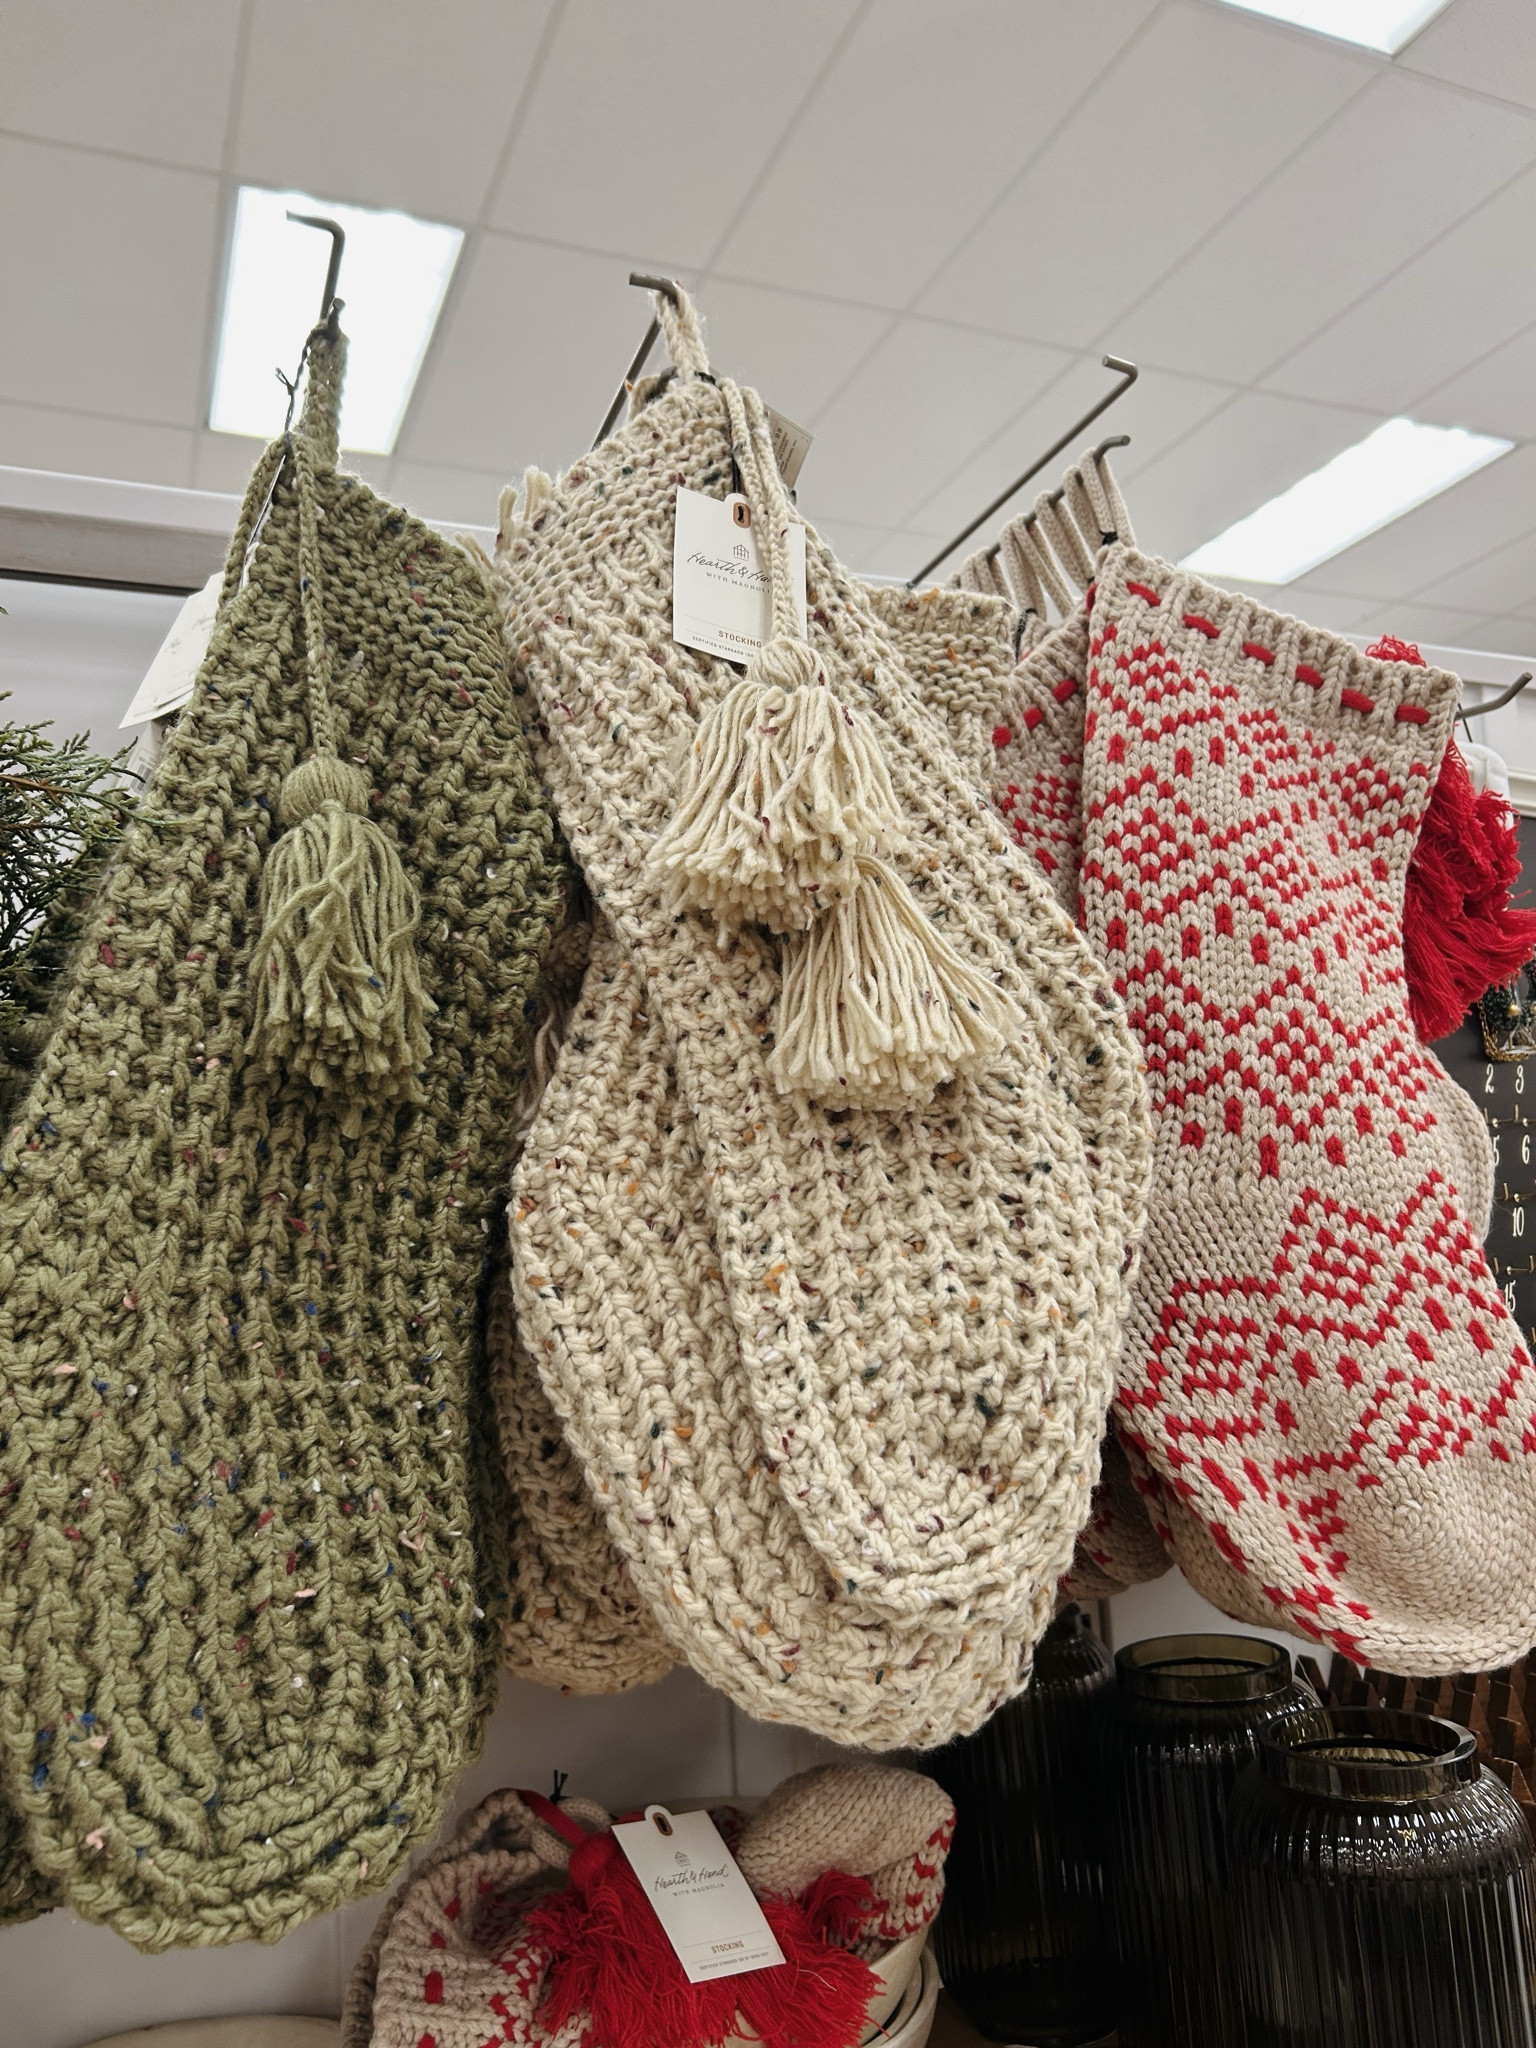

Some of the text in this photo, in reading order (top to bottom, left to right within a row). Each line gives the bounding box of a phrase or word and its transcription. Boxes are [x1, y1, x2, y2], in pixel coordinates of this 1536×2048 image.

[687, 552, 771, 583] Hearth & Ha
[706, 572, 770, 594] WITH MAGNOLI
[718, 630, 762, 648] STOCKING
[1485, 1063, 1494, 1094] 2
[1515, 1064, 1524, 1094] 3
[1493, 1134, 1500, 1166] 5
[1522, 1134, 1530, 1165] 6
[1512, 1206, 1525, 1237] 10
[1504, 1279, 1516, 1312] 15
[654, 1863, 729, 1892] Hearth & Hand
[692, 1882, 725, 1893] MAGNOLIA
[711, 1940, 745, 1954] STOCKING
